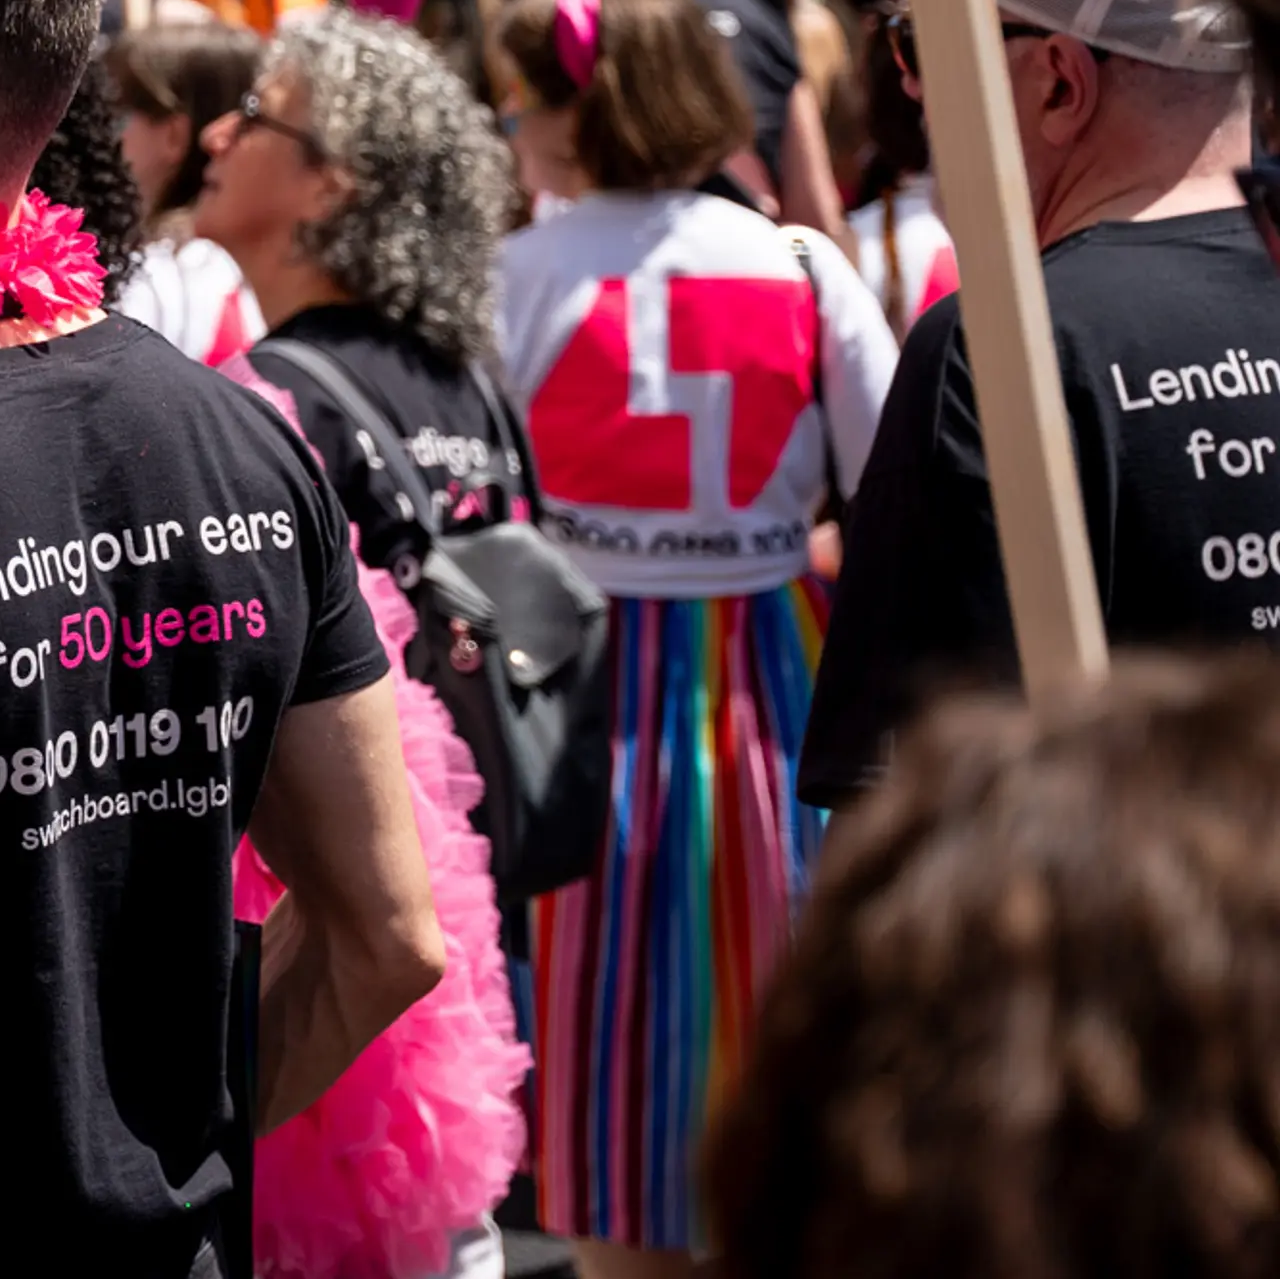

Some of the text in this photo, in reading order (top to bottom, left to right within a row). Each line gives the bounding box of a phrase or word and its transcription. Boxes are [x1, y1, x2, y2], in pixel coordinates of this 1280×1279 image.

[1186, 427, 1276, 481] for
[90, 519, 185, 573] our
[199, 509, 294, 556] ears
[58, 606, 112, 670] 50
[120, 597, 267, 669] years
[89, 709, 182, 768] 0119
[195, 696, 254, 753] 100
